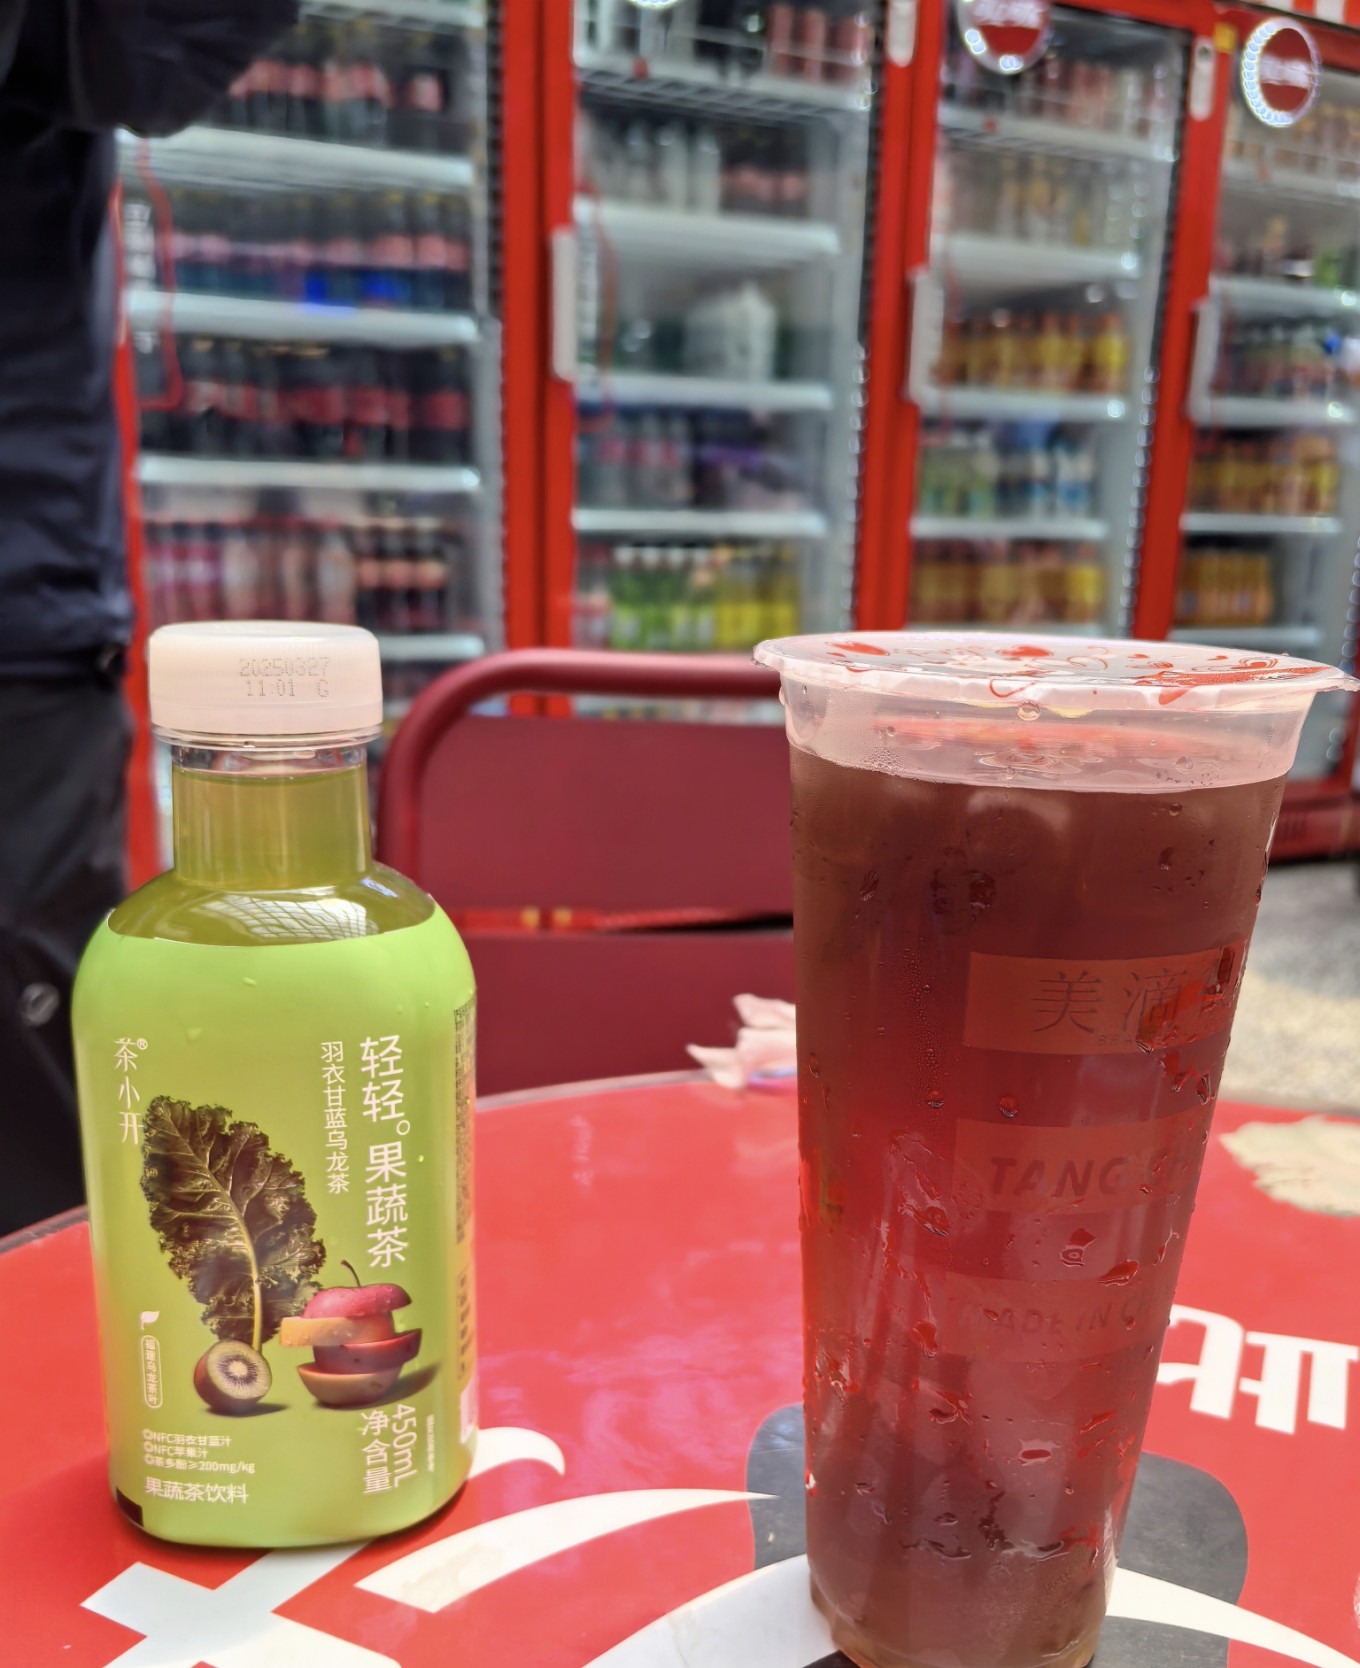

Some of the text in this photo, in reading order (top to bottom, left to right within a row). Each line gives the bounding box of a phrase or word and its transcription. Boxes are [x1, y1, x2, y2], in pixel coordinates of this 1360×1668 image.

[240, 657, 329, 677] 20250327
[246, 679, 295, 697] 11:01
[1033, 967, 1222, 1034] 美滴
[115, 1038, 145, 1145] 茶小开
[320, 1041, 350, 1195] 羽衣甘蓝乌龙茶
[361, 1410, 392, 1494] 净含量
[392, 1404, 417, 1488] 450mL
[145, 1477, 248, 1504] 果蔬茶饮料
